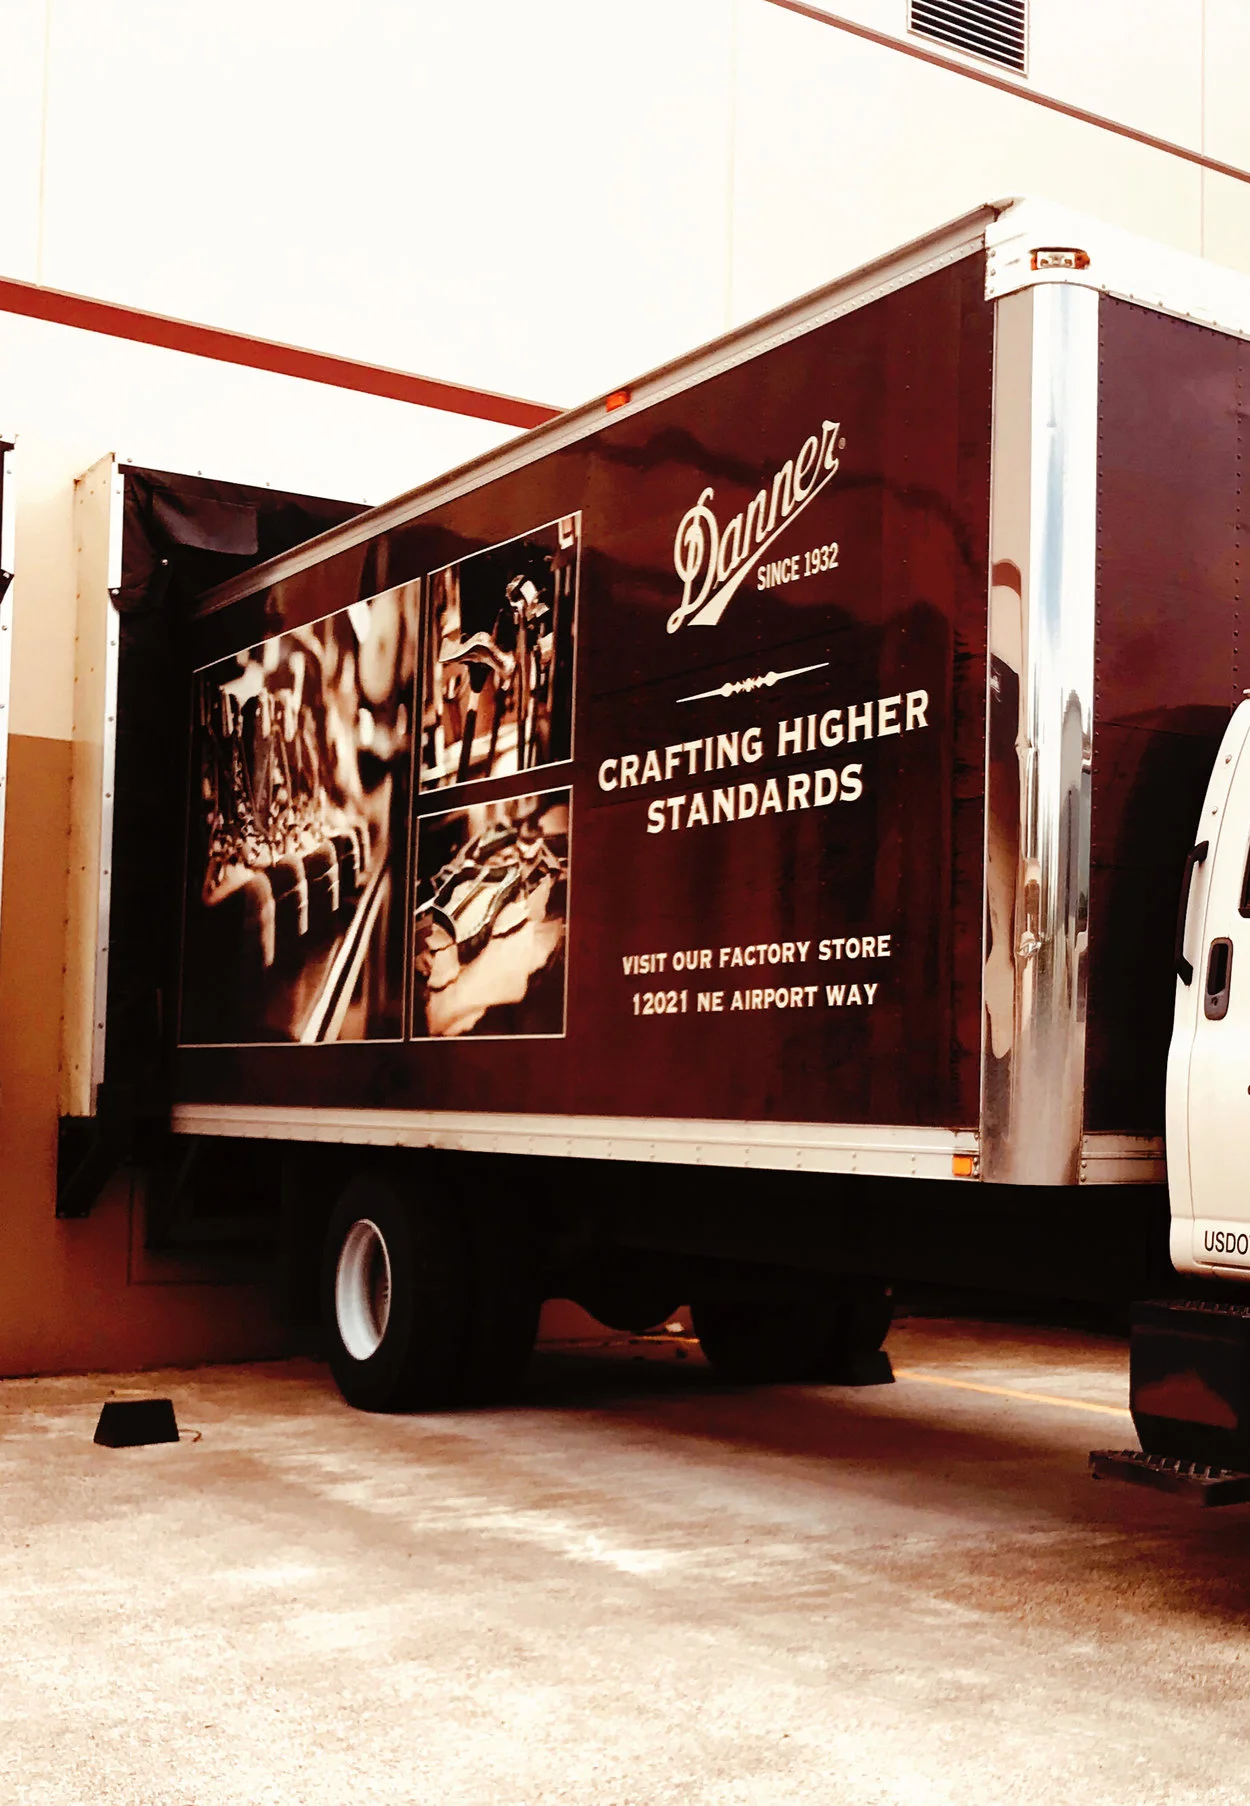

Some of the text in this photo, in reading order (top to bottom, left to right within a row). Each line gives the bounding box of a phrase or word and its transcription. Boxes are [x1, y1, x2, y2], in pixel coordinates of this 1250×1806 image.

[666, 419, 841, 634] Danner
[757, 542, 839, 591] SINCE 1932
[598, 689, 930, 791] CRAFTING HIGHER
[647, 763, 864, 834] STANDARDS
[622, 935, 892, 976] VISIT OUR FACTORY STORE
[632, 983, 878, 1015] 12021 NE AIRPORT WAY
